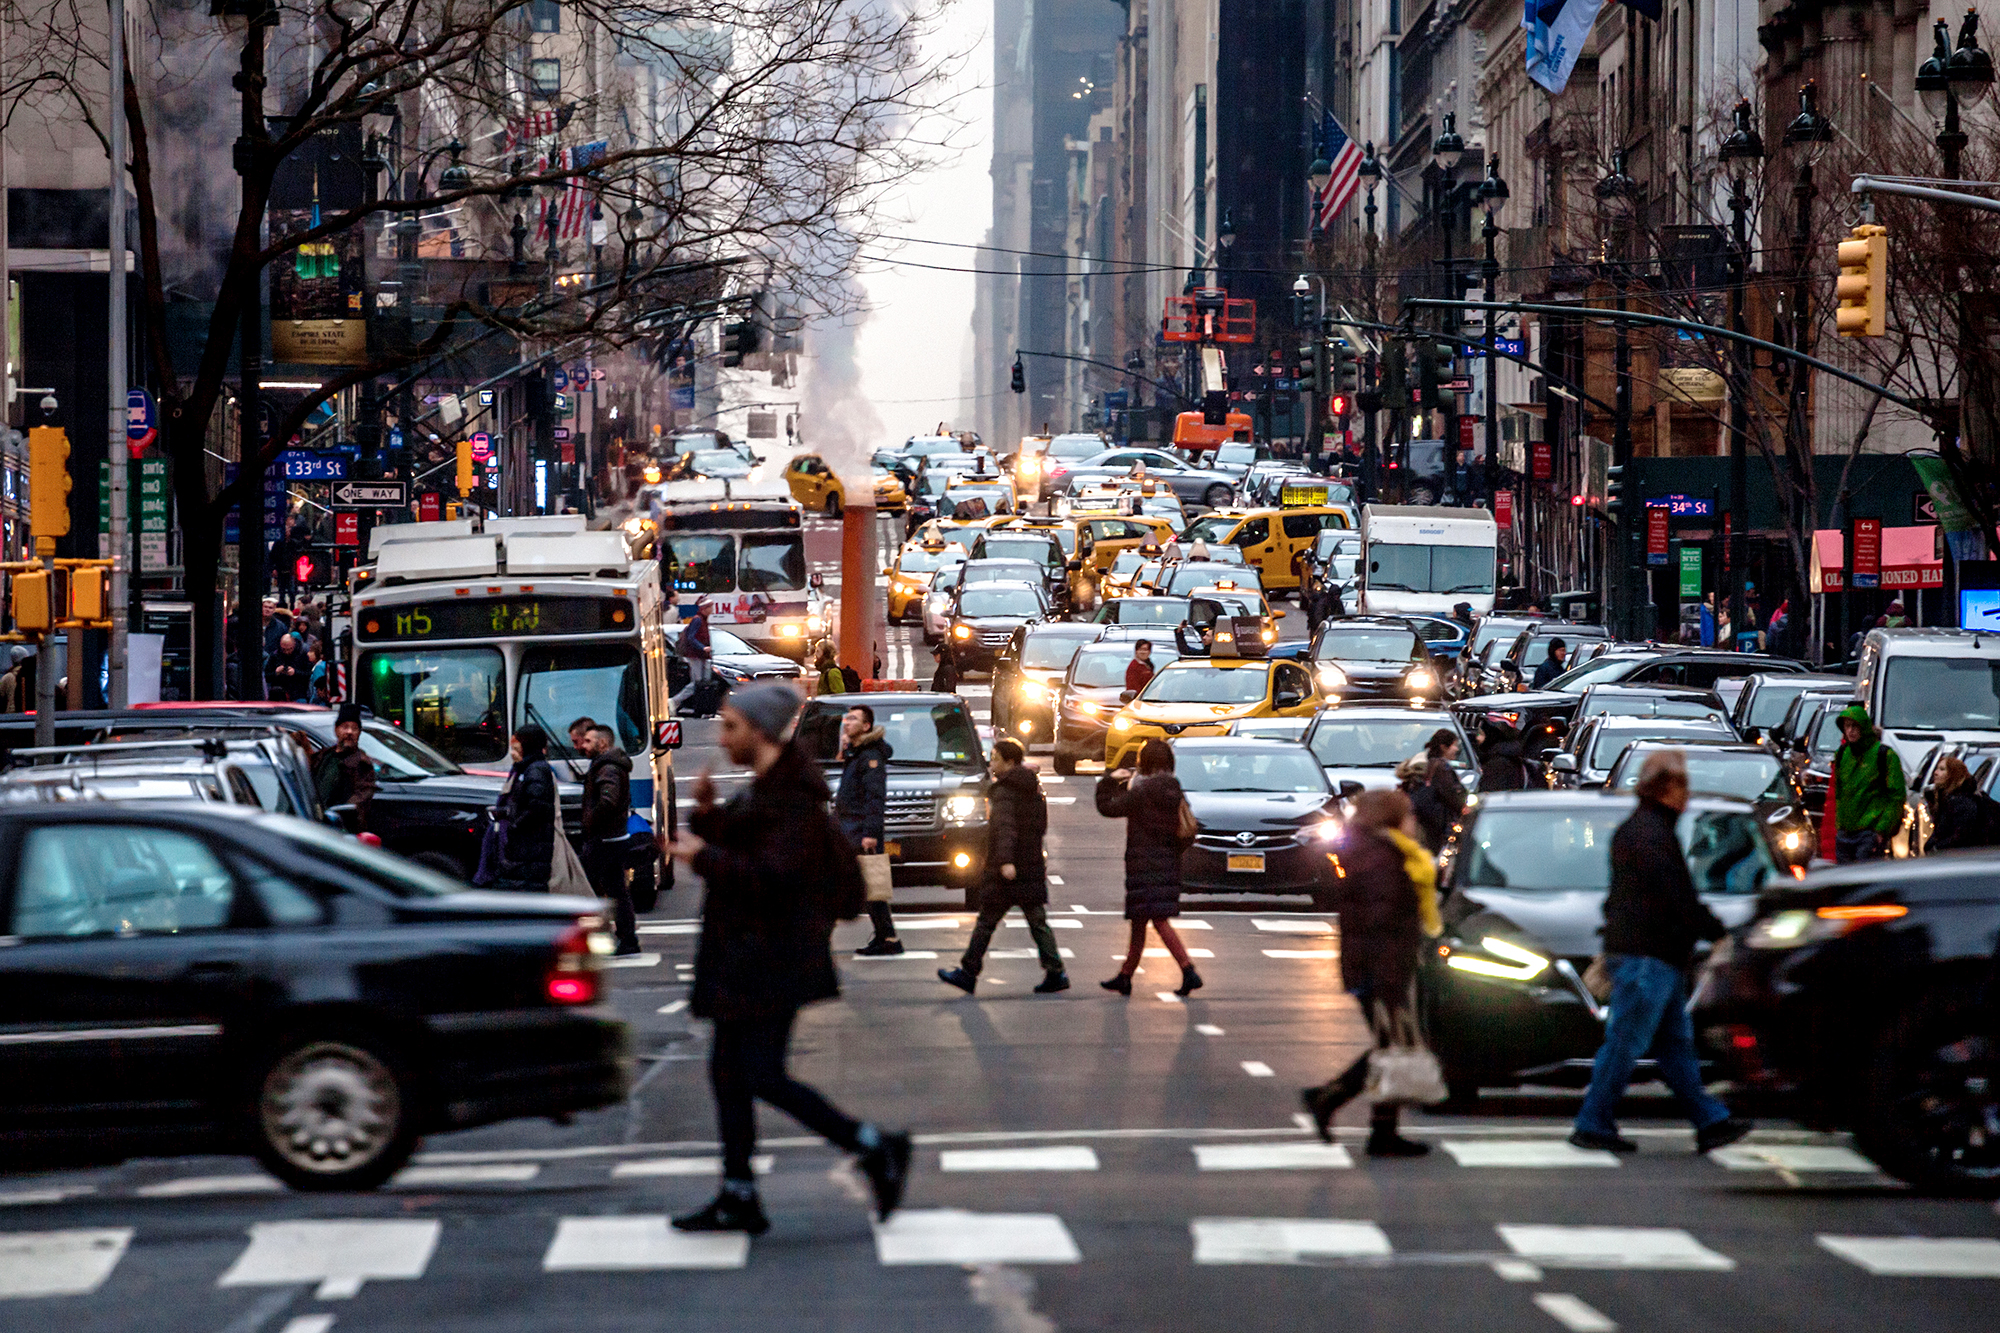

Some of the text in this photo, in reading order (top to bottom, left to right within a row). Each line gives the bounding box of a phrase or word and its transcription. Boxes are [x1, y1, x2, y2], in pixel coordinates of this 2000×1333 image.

[295, 460, 322, 476] 33rd
[326, 461, 342, 476] St
[343, 489, 394, 499] ONE WAY
[1671, 502, 1692, 513] 34th
[1695, 502, 1707, 514] St
[396, 607, 432, 635] M5
